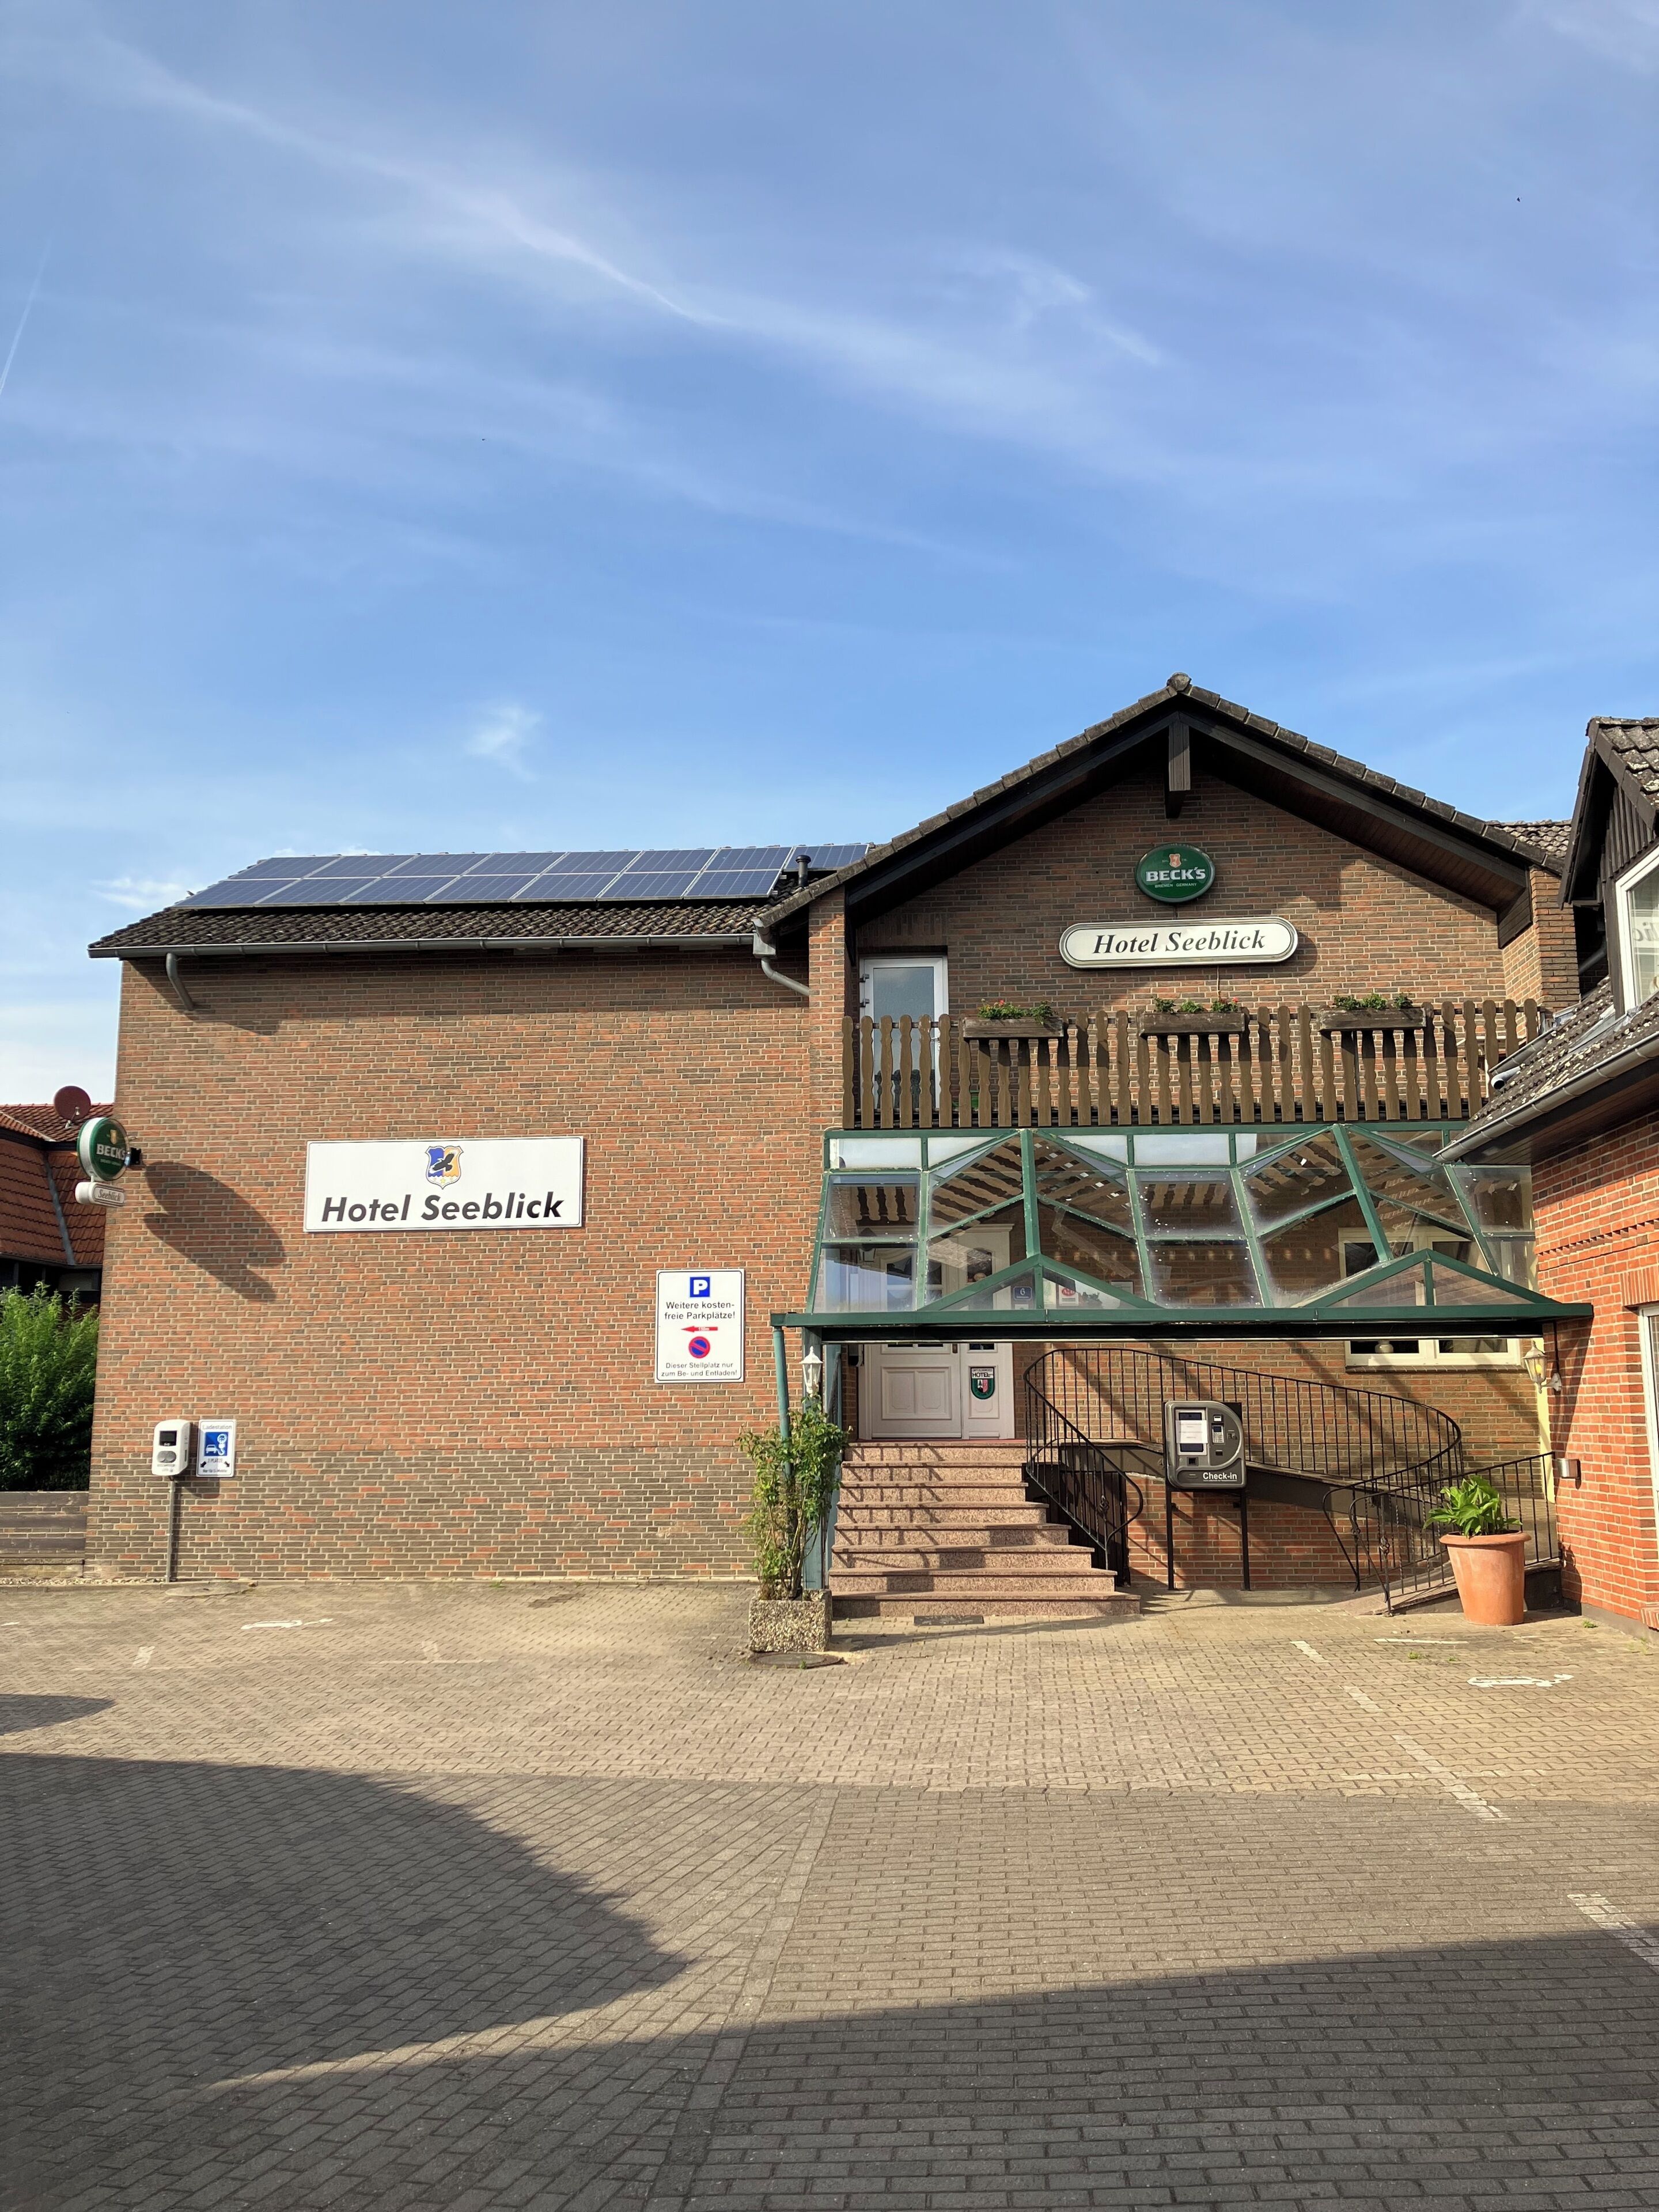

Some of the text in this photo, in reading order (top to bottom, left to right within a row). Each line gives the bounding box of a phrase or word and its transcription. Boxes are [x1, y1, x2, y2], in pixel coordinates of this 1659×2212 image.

[1146, 866, 1206, 882] BECK'S
[1092, 930, 1266, 954] Hotel Seeblick
[98, 1189, 121, 1202] Seeblick
[321, 1191, 565, 1222] Hotel Seeblick
[693, 1279, 708, 1296] P
[666, 1301, 734, 1309] Weitere kosten-
[664, 1311, 735, 1321] freie Parkplätze!
[689, 1362, 720, 1370] Stellplatz
[1203, 1472, 1237, 1480] Check-in
